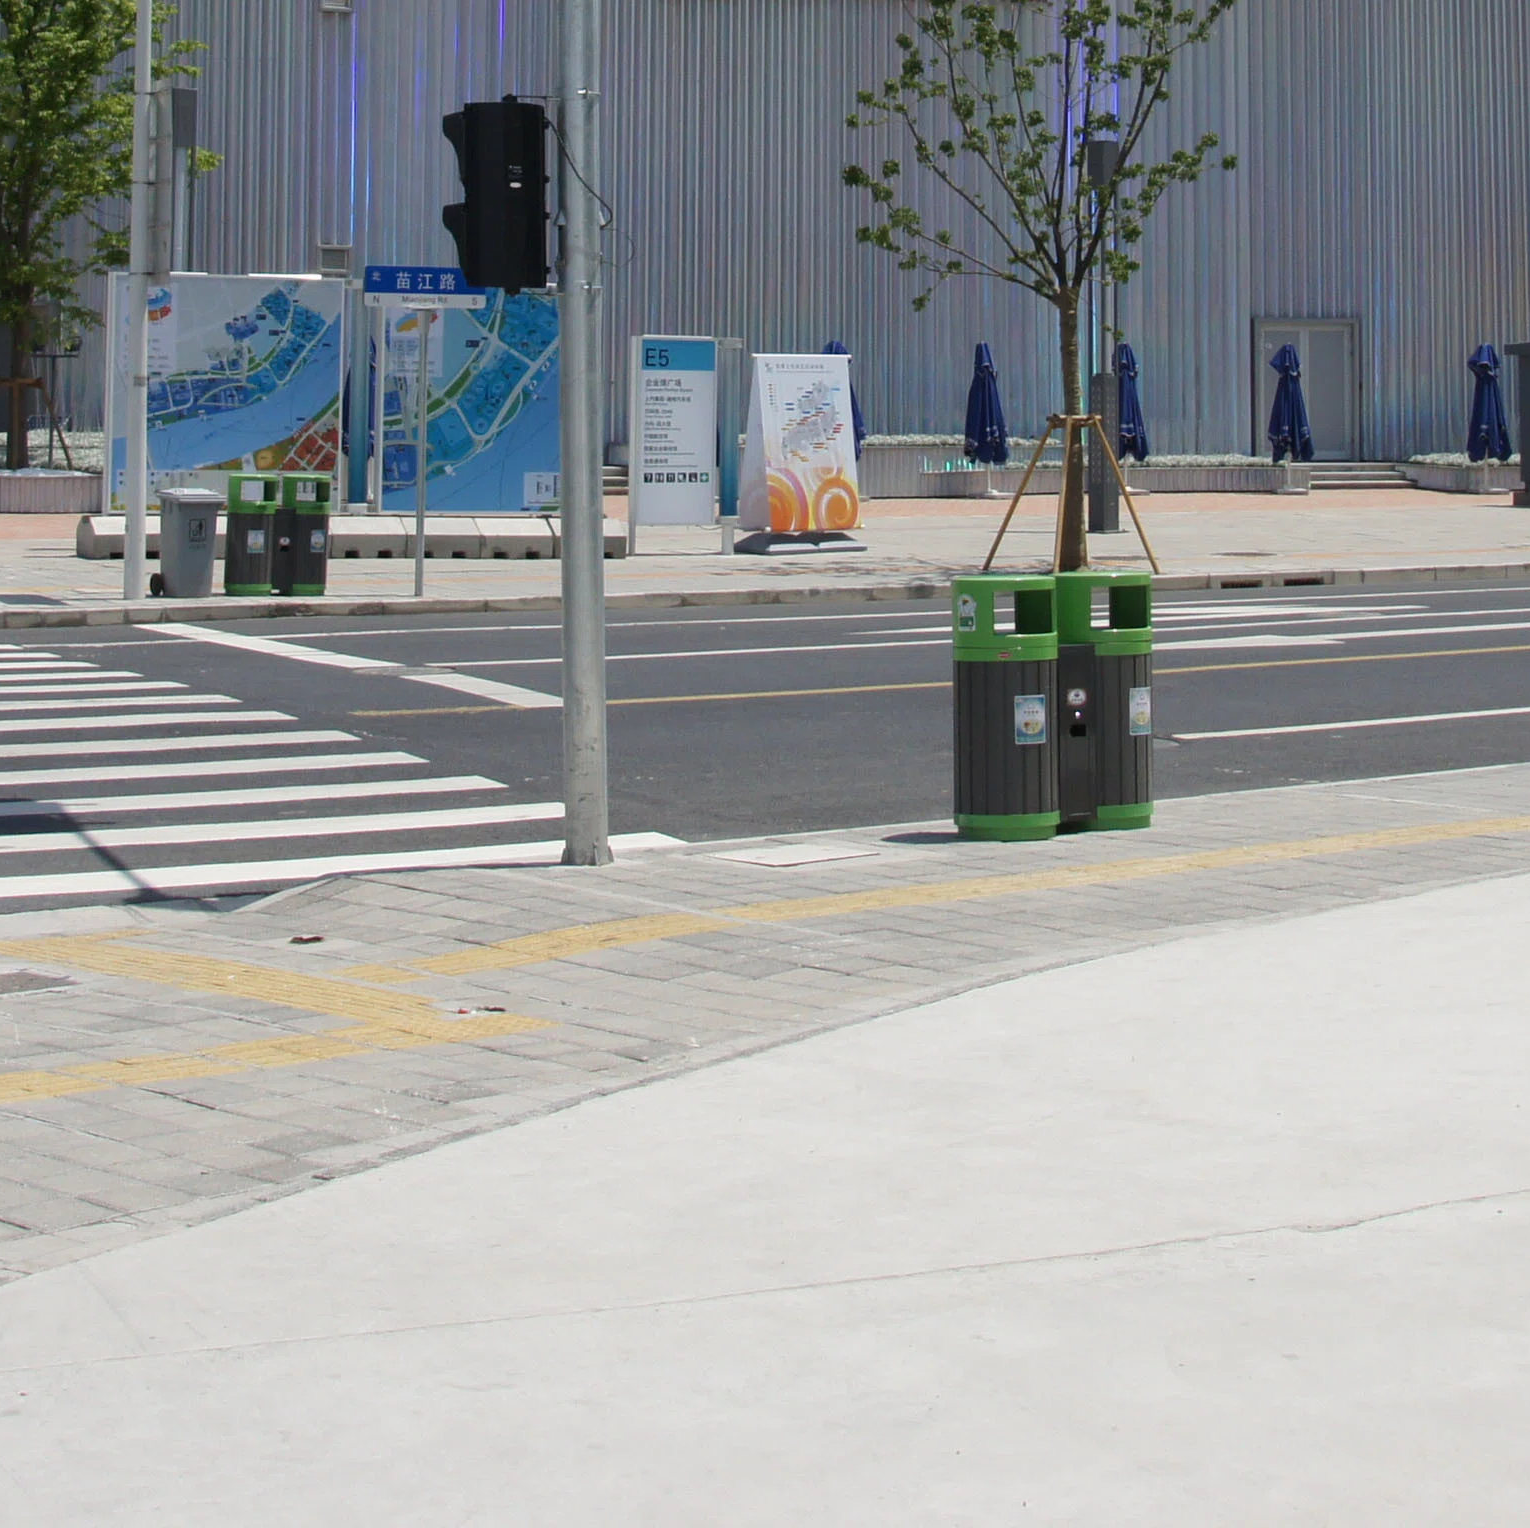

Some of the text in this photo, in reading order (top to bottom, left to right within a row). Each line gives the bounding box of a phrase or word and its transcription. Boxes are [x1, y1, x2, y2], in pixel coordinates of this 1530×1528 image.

[396, 272, 456, 290] 苗江路
[645, 348, 669, 367] E5
